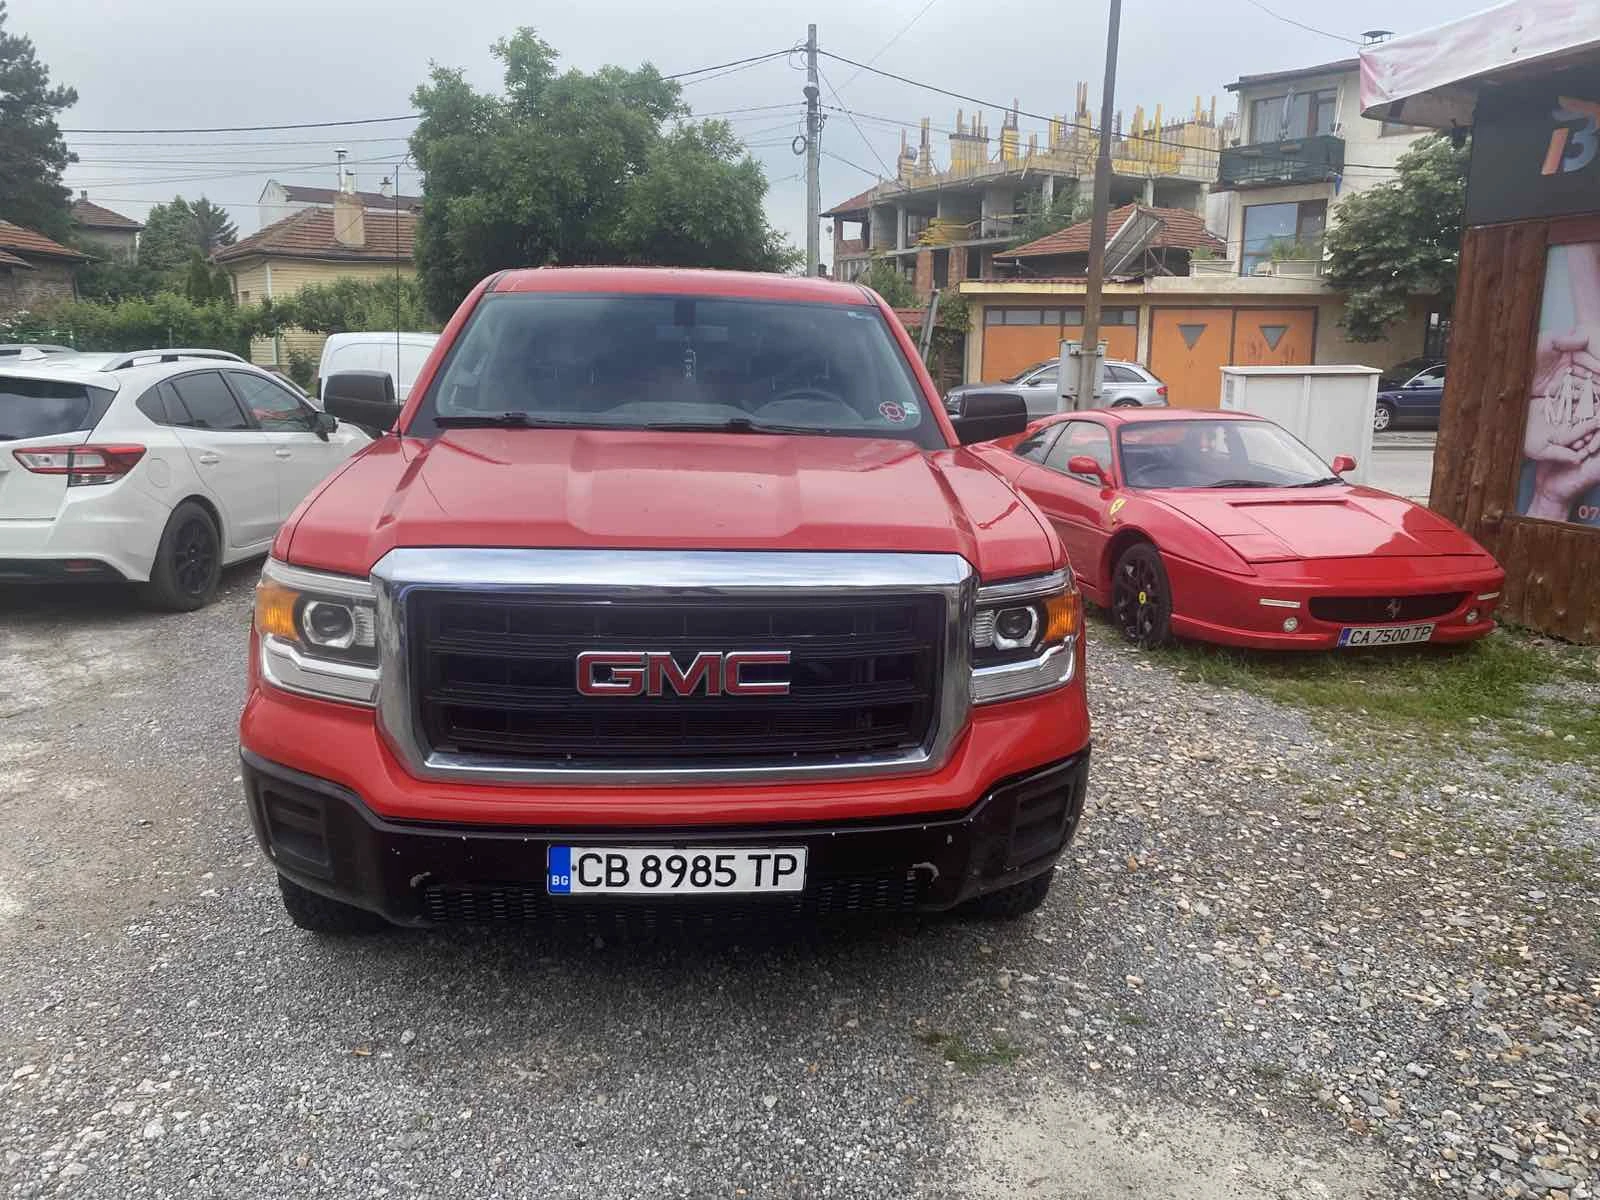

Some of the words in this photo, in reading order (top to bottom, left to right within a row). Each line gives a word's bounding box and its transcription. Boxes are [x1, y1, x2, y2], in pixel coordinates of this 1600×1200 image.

[1350, 630, 1372, 644] CA
[1373, 628, 1410, 643] 7500
[1411, 626, 1432, 641] TP
[576, 650, 791, 696] GMC
[551, 874, 569, 887] BG
[577, 853, 630, 888] CB
[639, 854, 737, 888] 8985
[747, 853, 798, 887] TP
